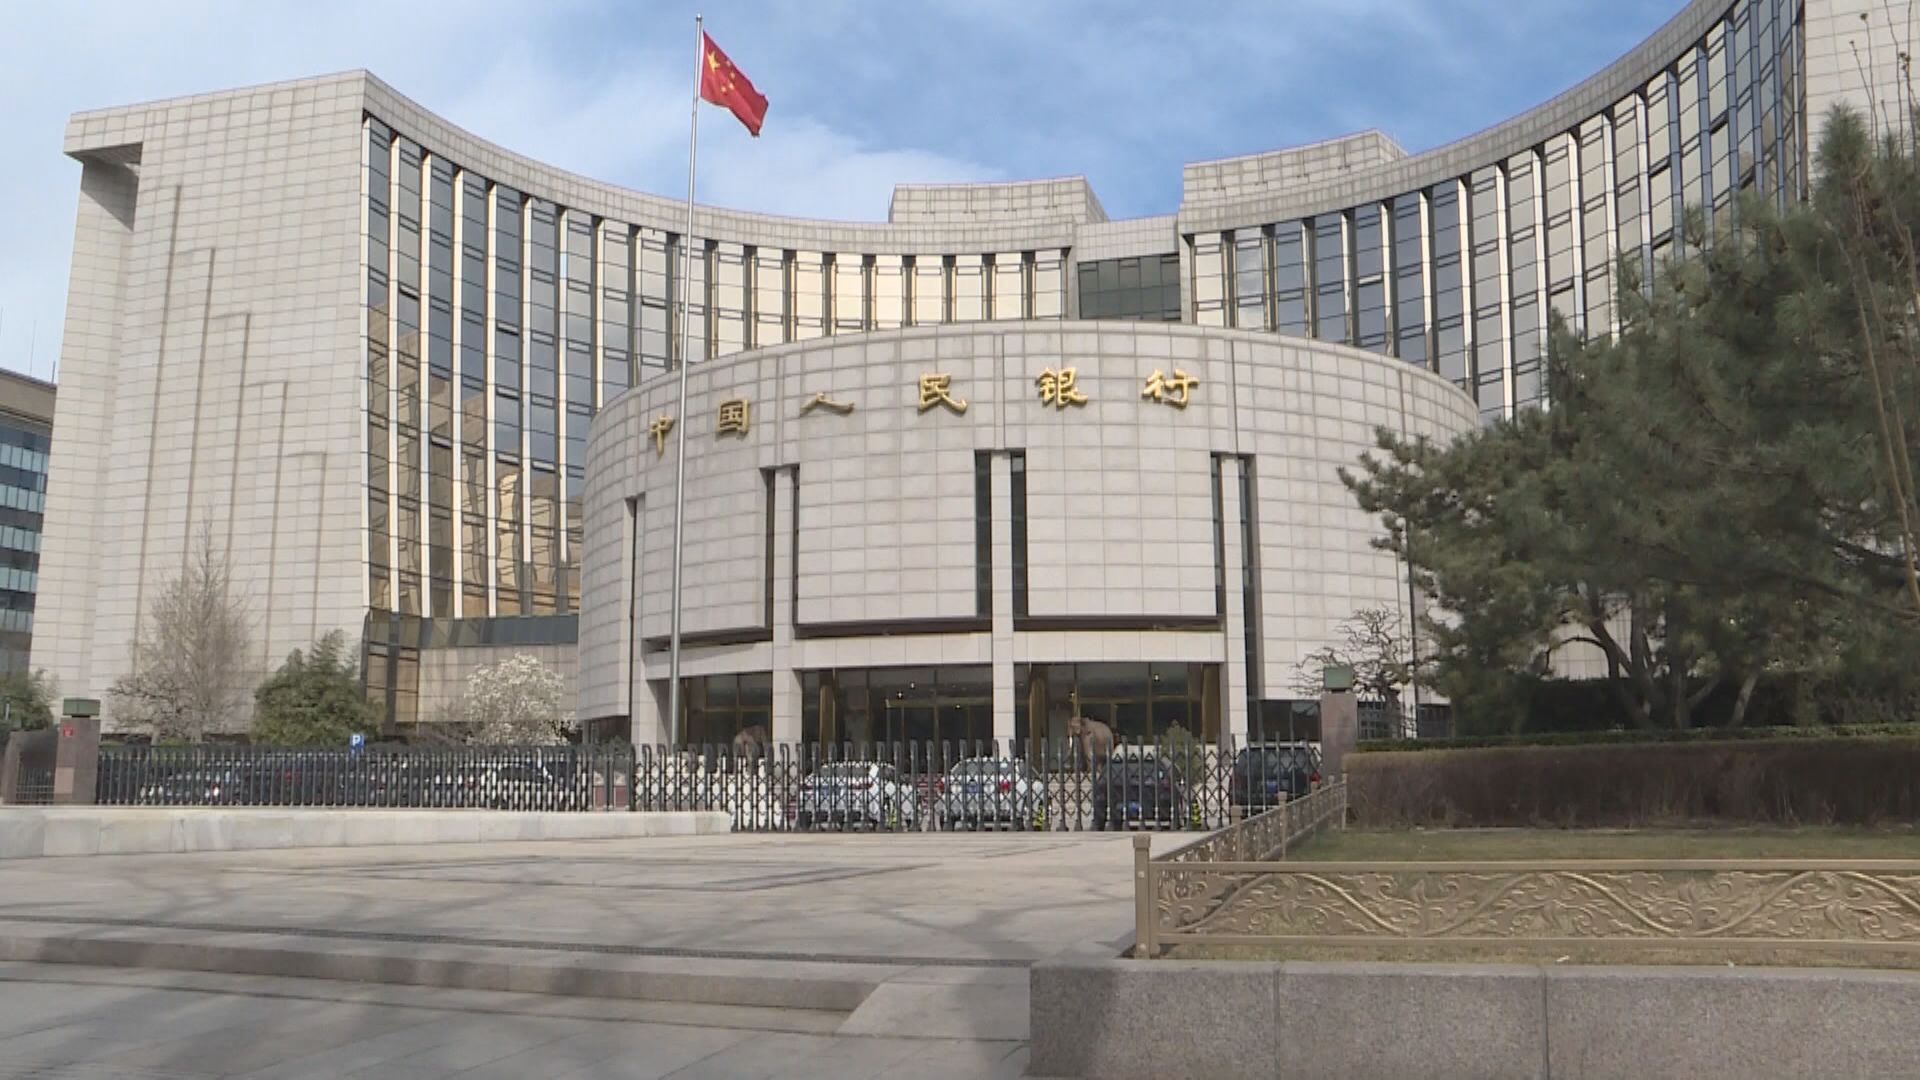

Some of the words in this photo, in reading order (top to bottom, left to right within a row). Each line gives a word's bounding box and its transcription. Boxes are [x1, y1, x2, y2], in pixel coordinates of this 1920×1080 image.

[649, 367, 1199, 459] 中国人民银行
[352, 734, 361, 747] P
